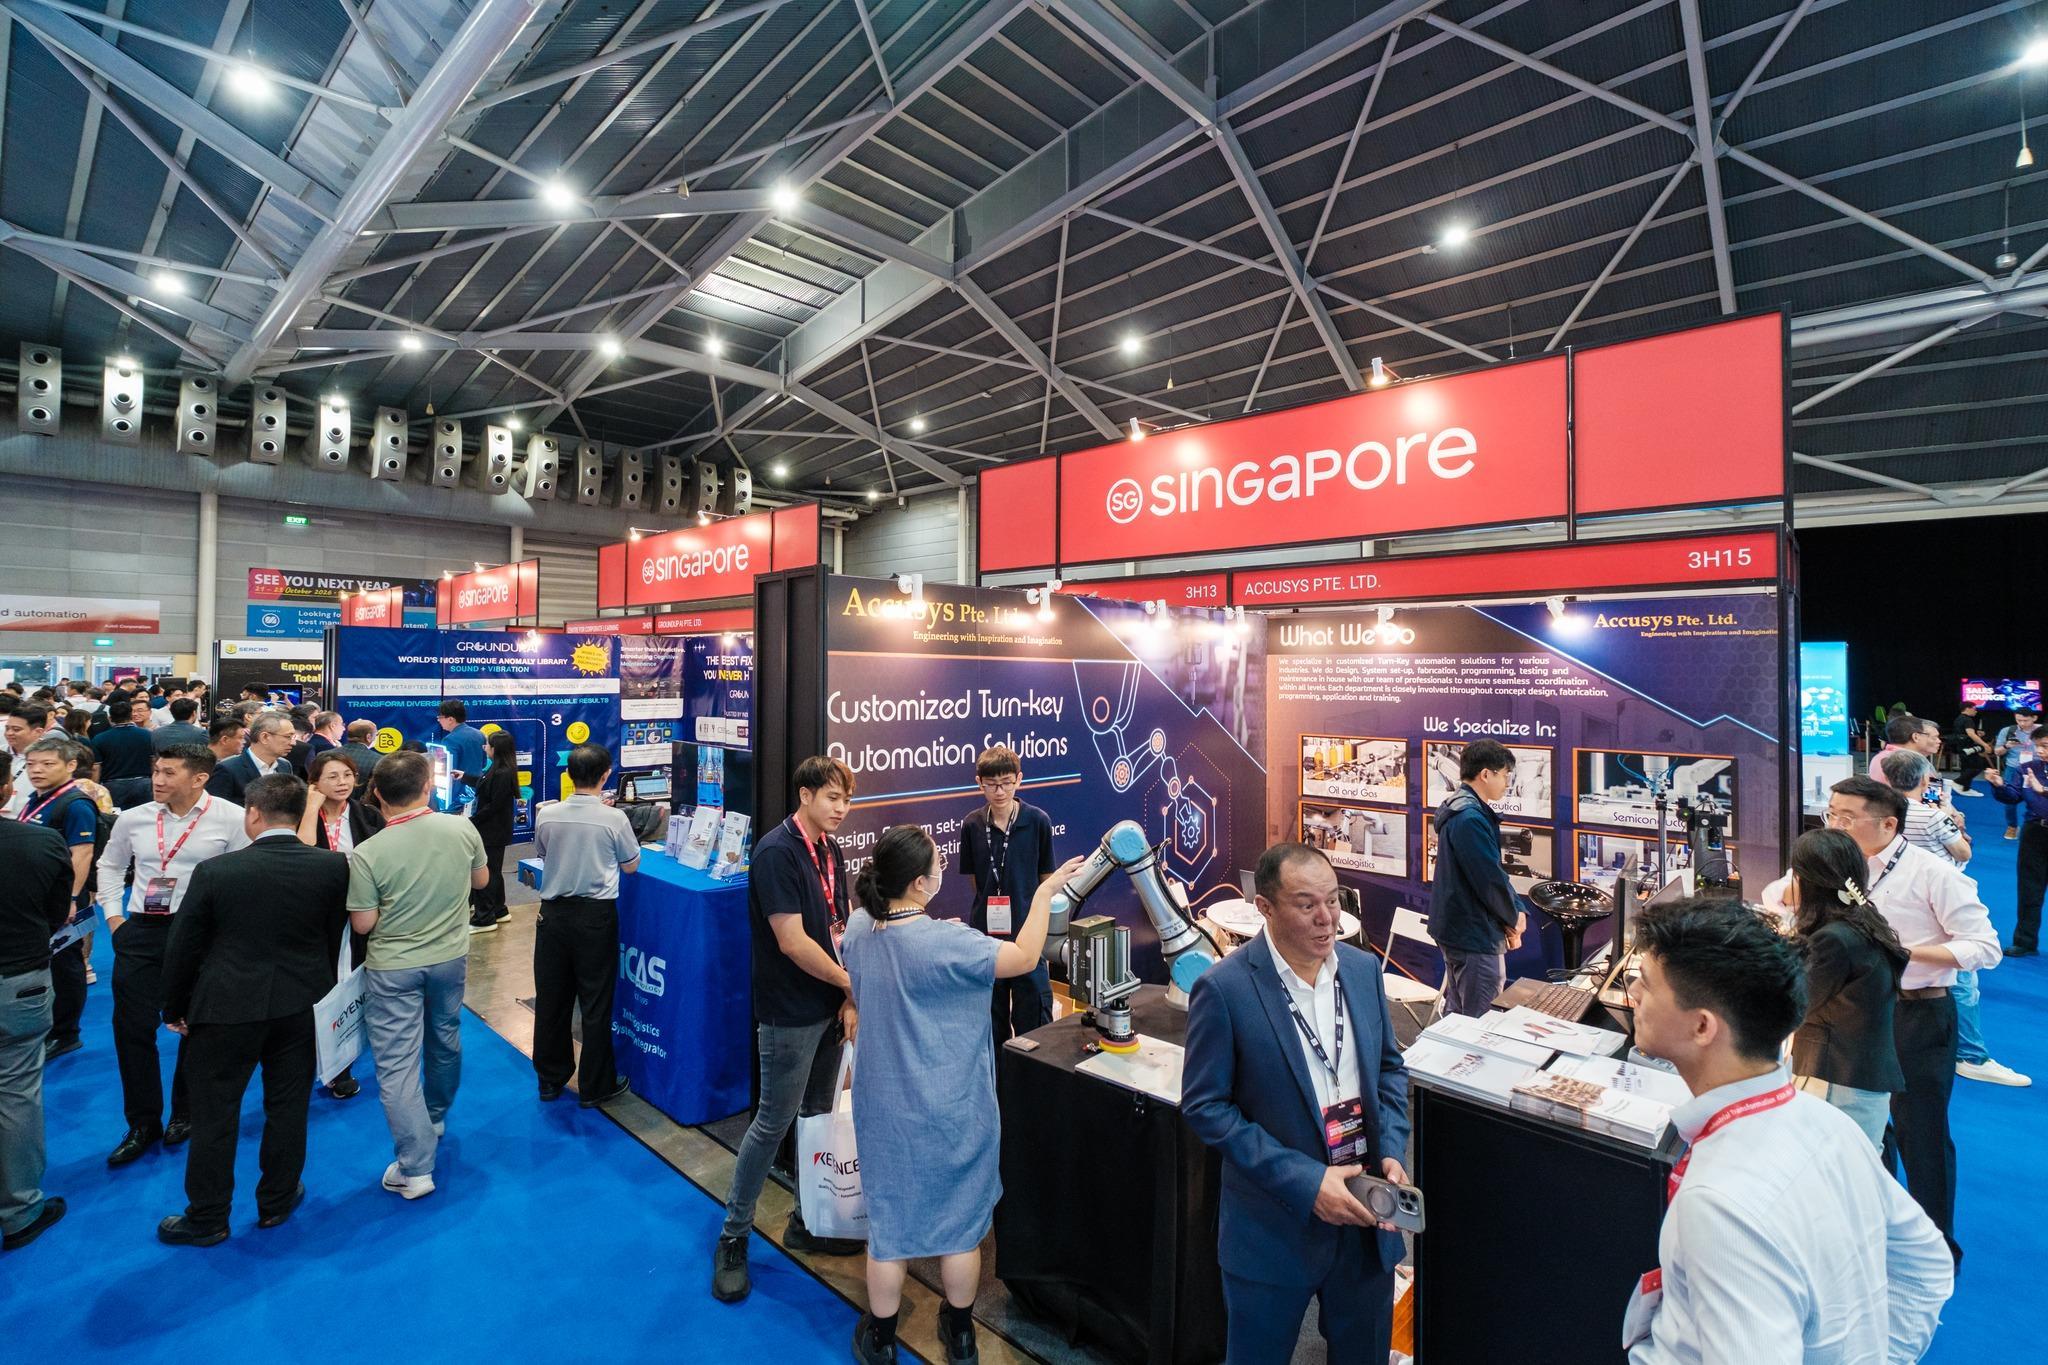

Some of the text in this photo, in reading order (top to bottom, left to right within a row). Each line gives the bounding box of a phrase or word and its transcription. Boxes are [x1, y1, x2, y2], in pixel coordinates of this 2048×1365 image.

[1687, 549, 1752, 570] 3H15
[254, 574, 391, 591] SEE YOU NEXT YEAR
[1245, 570, 1382, 597] ACCUSYS PTE. LTD.
[284, 586, 312, 594] October
[1186, 586, 1217, 599] 3H13
[14, 610, 88, 619] automation
[298, 610, 331, 618] Looking
[960, 604, 989, 624] Pte.
[1593, 613, 1738, 632] Accusys Pte. Ltd.
[913, 630, 1063, 648] Engineering with Inspiration and Imagination
[1280, 622, 1416, 646] What We Do
[1640, 630, 1677, 638] Engineering
[398, 656, 438, 664] WORLD'S
[537, 658, 568, 666] LIBRARY
[706, 656, 720, 666] THE
[722, 656, 740, 666] BEST
[1292, 657, 1322, 666] specialize
[1326, 657, 1332, 665] in
[1336, 657, 1374, 665] customized
[1378, 657, 1410, 666] Turn-Key
[1414, 656, 1456, 665] automation
[1460, 656, 1496, 665] solutions
[1501, 656, 1514, 665] for
[1518, 656, 1550, 665] various
[704, 670, 718, 680] YOU
[718, 670, 742, 680] NEVER
[1312, 666, 1322, 674] We
[1324, 666, 1334, 674] do
[1362, 667, 1388, 676] System
[1520, 666, 1548, 676] testing
[1552, 666, 1569, 675] and
[292, 674, 322, 683] Total
[1346, 676, 1362, 684] with
[1396, 676, 1403, 684] of
[1404, 676, 1453, 684] professionals
[1492, 677, 1530, 685] seamless
[1534, 676, 1589, 686] coordination
[1328, 684, 1344, 692] Each
[1344, 685, 1384, 694] department
[1392, 685, 1416, 694] closely
[1418, 686, 1448, 694] involved
[1450, 686, 1493, 696] throughout
[1494, 687, 1527, 696] concept
[532, 698, 578, 706] ACTIONABLE
[1322, 693, 1358, 702] application
[1358, 694, 1372, 702] and
[826, 688, 1064, 724] Customized Turn-key
[552, 714, 562, 726] 3
[1424, 716, 1556, 738] We Specialize In:
[826, 736, 976, 774] Automation
[1328, 786, 1378, 798] Oil and Gas
[1330, 855, 1376, 869] Intralogistics
[814, 1152, 860, 1176] KENCE
